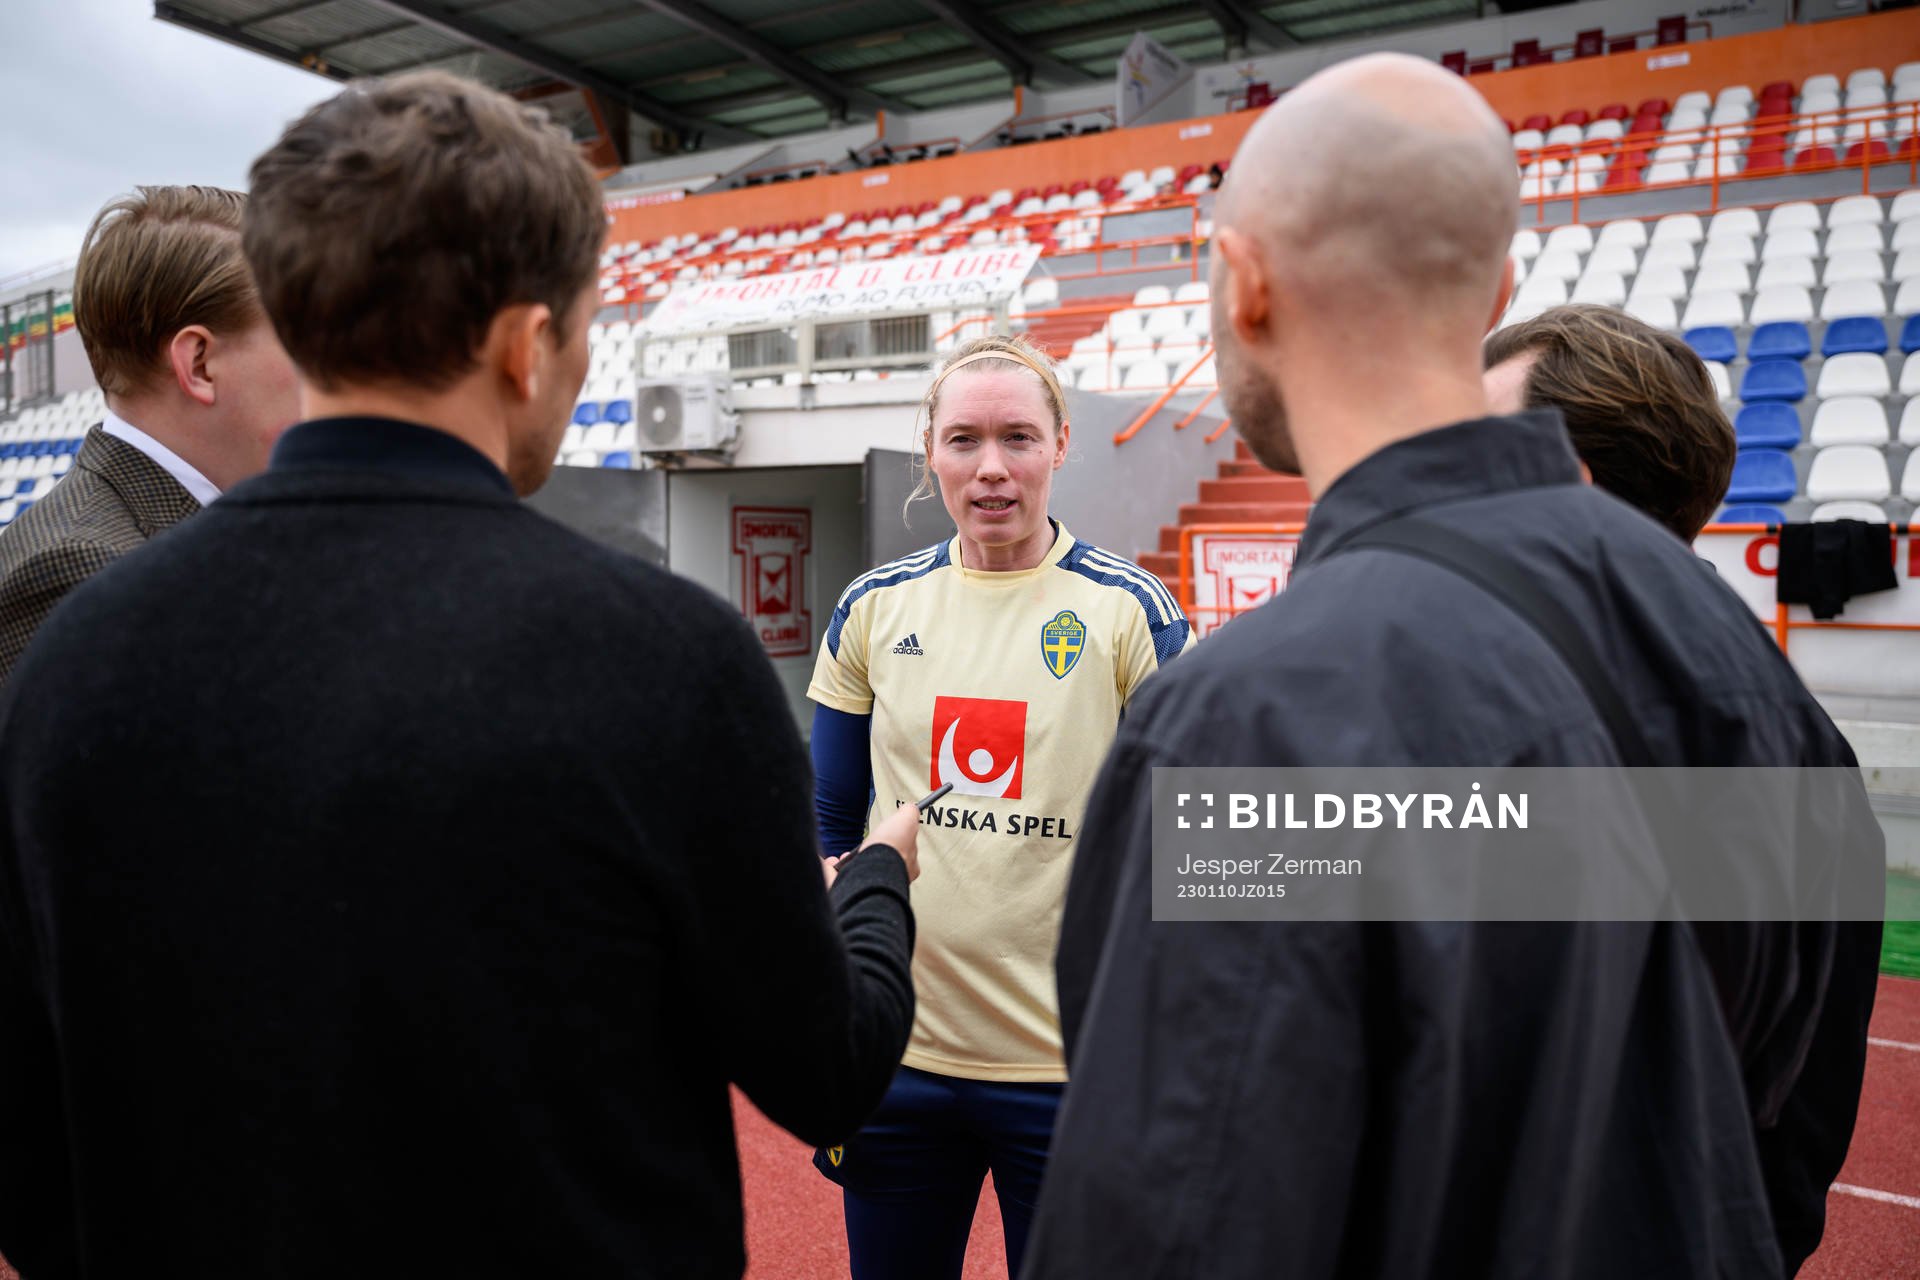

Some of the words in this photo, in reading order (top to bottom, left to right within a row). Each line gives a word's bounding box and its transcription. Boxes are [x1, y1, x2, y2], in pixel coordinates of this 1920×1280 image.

[903, 252, 1027, 283] CLUBE
[892, 645, 924, 656] adidas
[1006, 814, 1073, 839] SPEL
